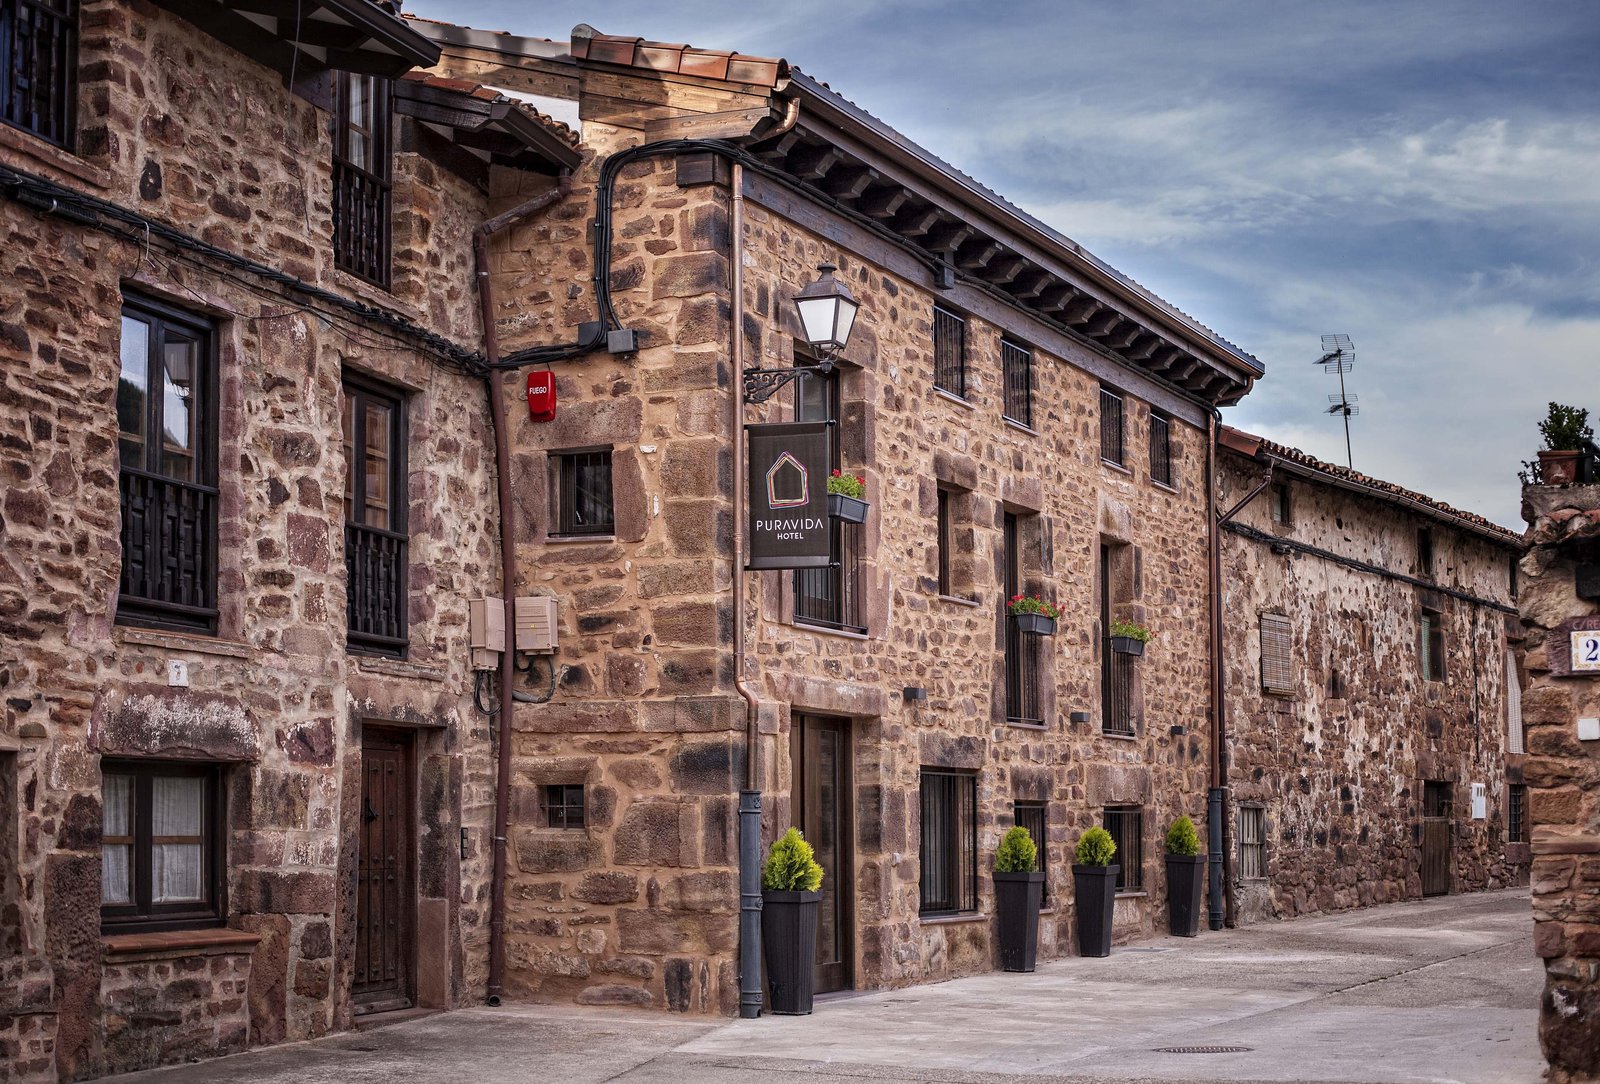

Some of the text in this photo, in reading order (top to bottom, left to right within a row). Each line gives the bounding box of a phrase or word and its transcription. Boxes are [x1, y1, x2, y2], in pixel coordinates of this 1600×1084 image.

[529, 386, 547, 394] FUEGO
[756, 518, 824, 531] PURAVIDA
[777, 532, 804, 540] HOTEL
[1585, 639, 1599, 661] 2
